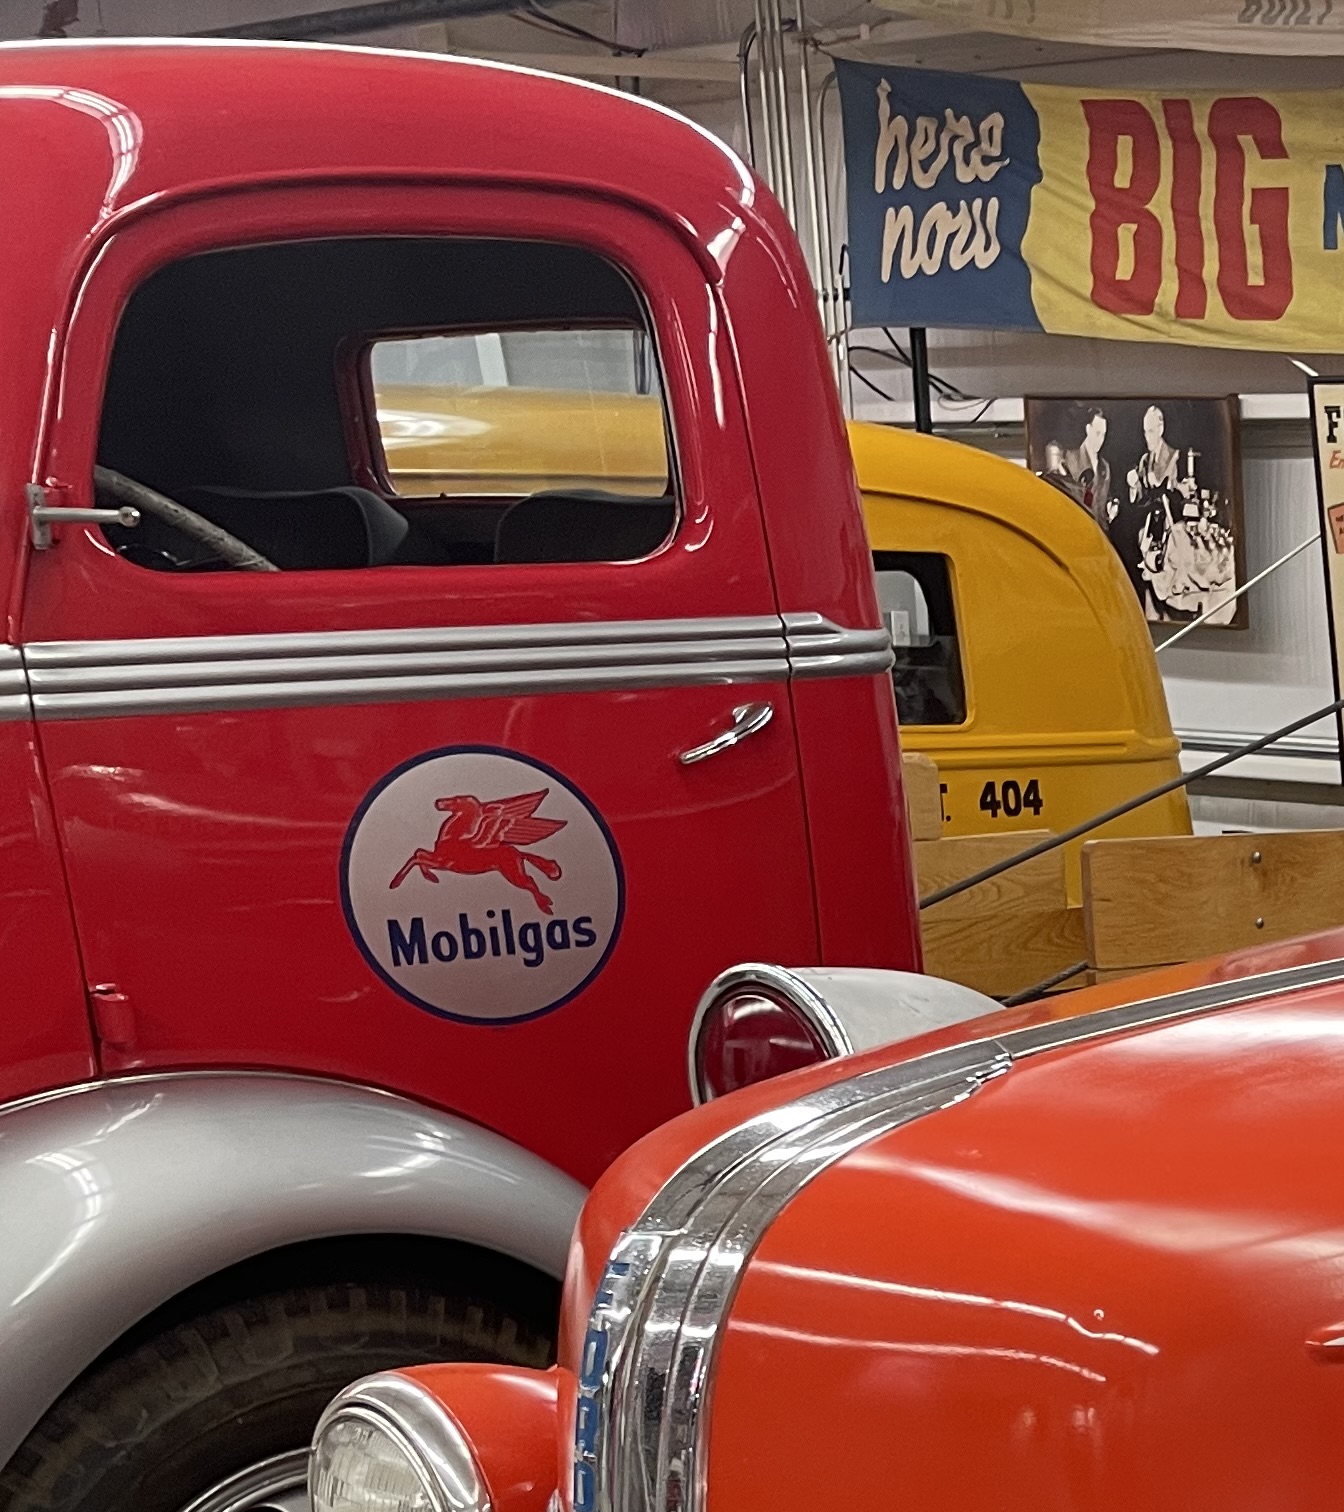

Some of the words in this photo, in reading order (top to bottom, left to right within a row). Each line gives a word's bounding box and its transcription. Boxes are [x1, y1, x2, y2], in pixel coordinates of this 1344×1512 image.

[874, 76, 1011, 194] here
[881, 196, 1002, 285] now
[1080, 96, 1295, 322] BIG
[978, 778, 1044, 819] 404
[386, 908, 598, 968] Mobilgas
